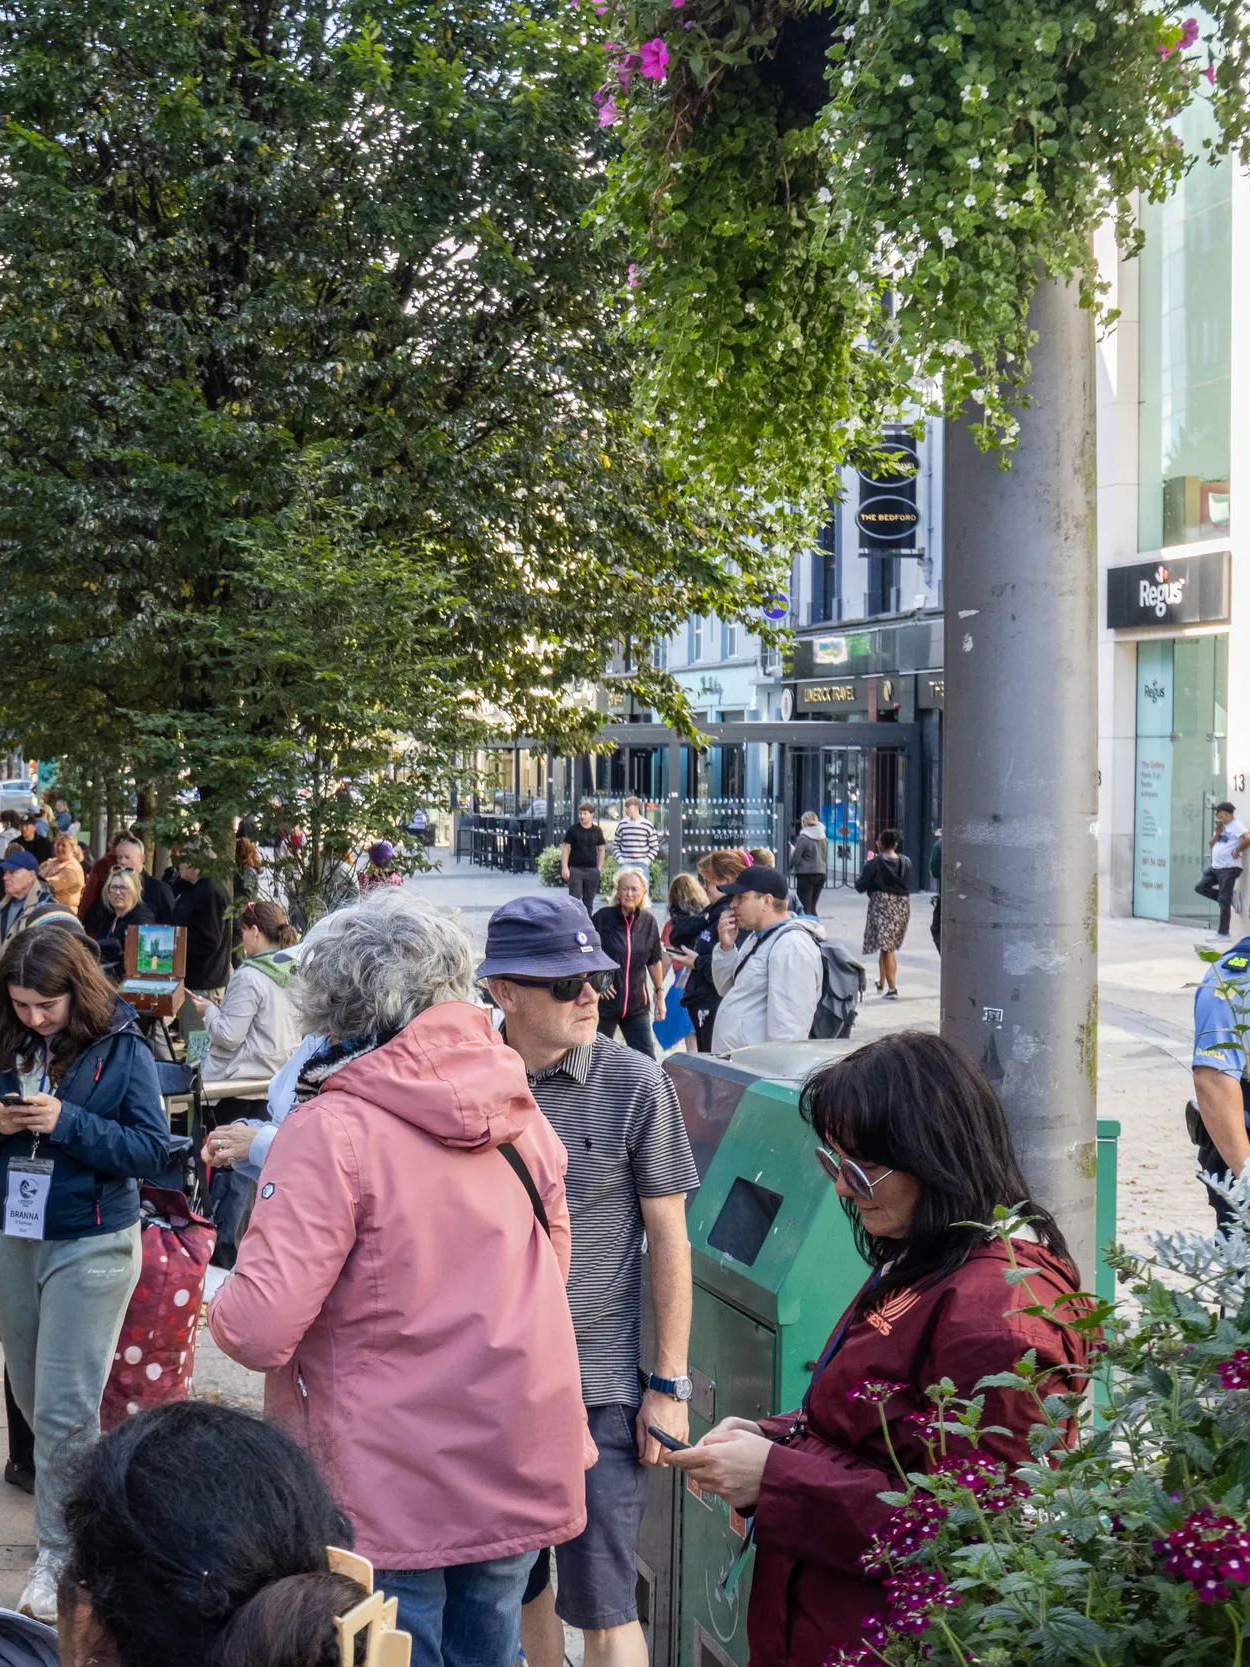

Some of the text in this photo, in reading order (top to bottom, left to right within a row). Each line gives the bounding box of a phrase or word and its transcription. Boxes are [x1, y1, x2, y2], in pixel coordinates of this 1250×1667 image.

[860, 513, 917, 522] THE BEDFORD
[1139, 580, 1183, 618] Regus
[804, 685, 855, 702] LIMERICK TRAVEL
[1144, 684, 1165, 704] Regus
[1233, 773, 1245, 792] 13
[10, 1210, 39, 1220] BRANNA
